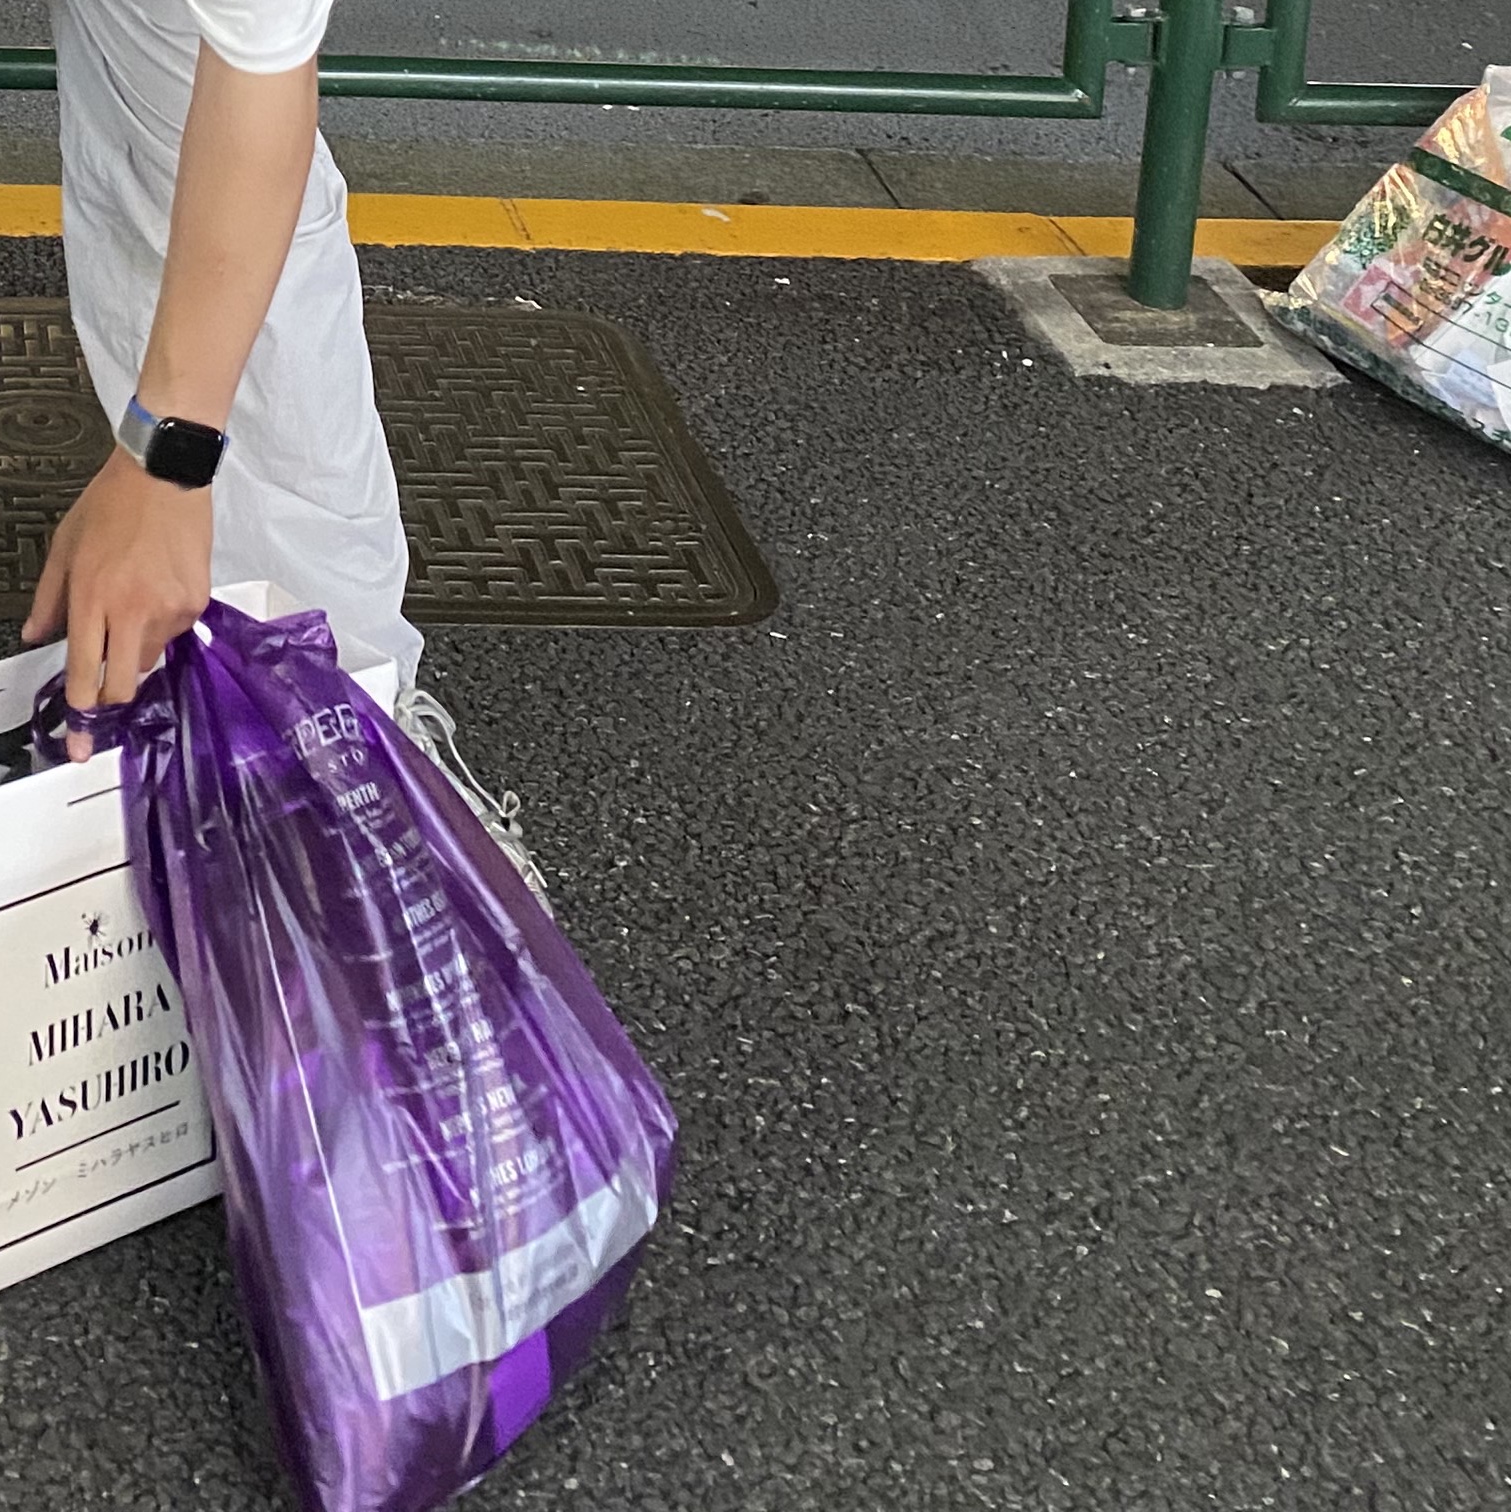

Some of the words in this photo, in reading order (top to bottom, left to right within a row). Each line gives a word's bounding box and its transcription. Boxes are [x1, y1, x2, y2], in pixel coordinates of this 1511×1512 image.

[44, 928, 155, 989] Maison
[28, 983, 171, 1067] MIHARA
[8, 1040, 190, 1141] YASUHIRO
